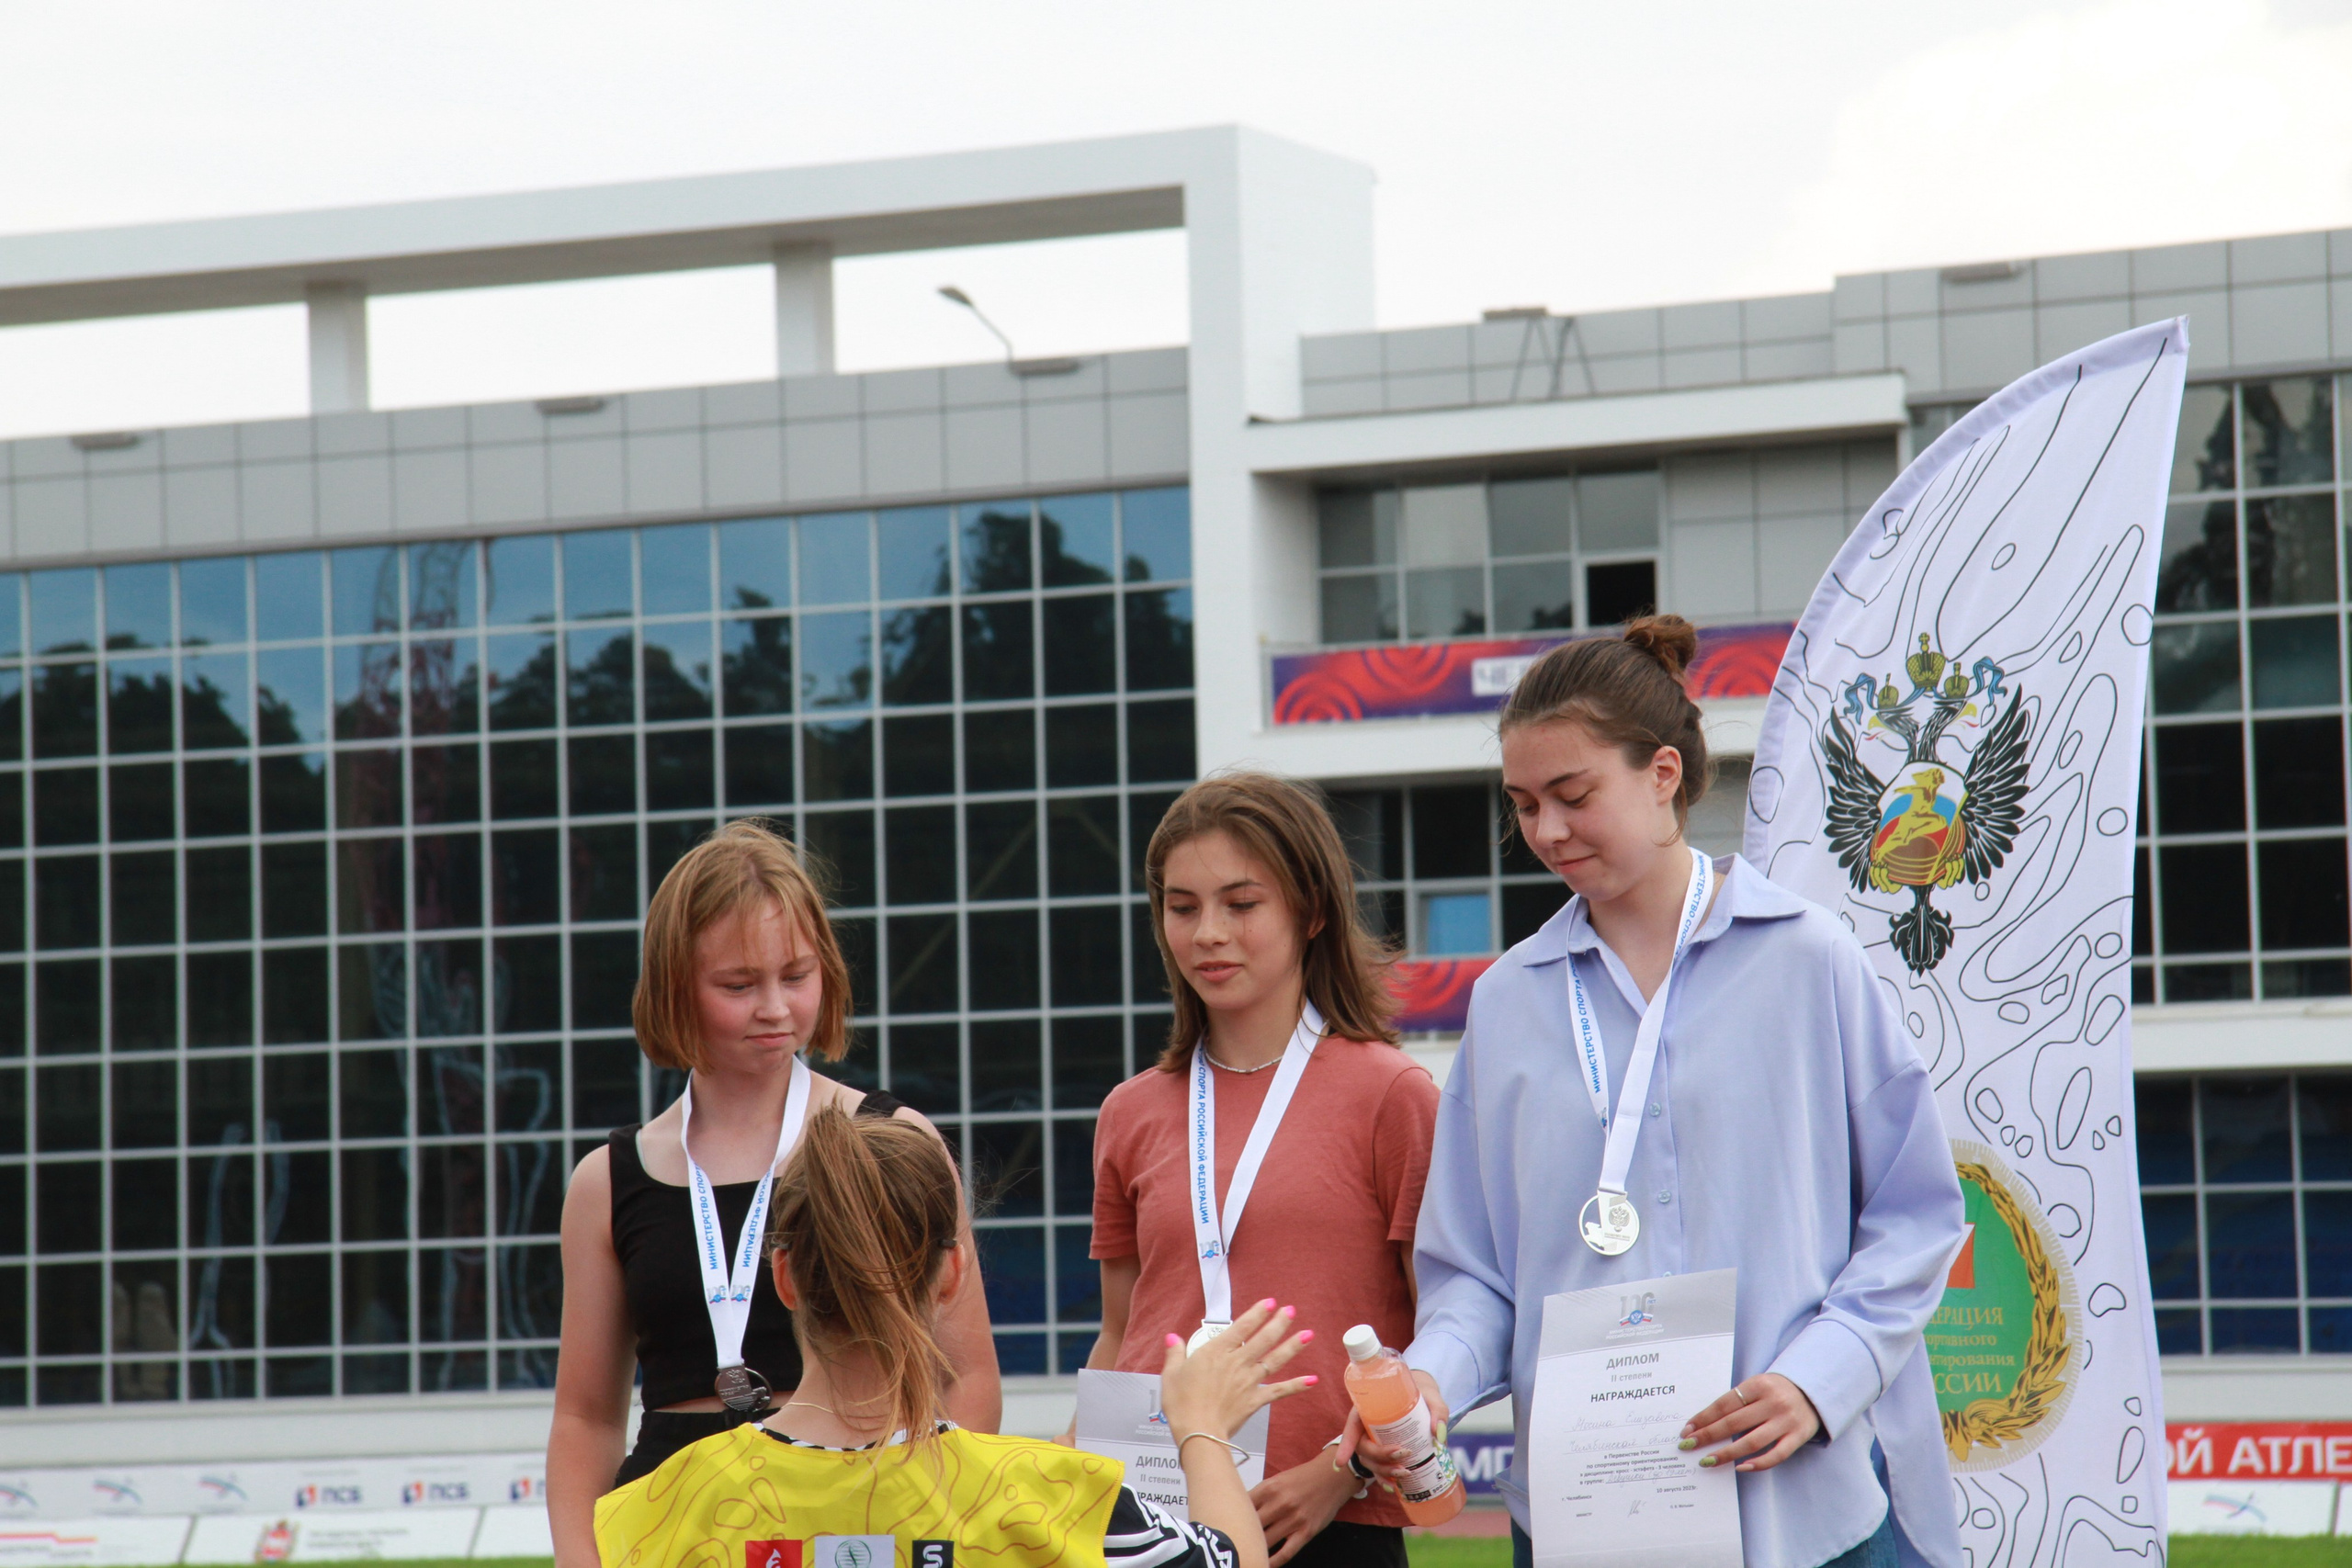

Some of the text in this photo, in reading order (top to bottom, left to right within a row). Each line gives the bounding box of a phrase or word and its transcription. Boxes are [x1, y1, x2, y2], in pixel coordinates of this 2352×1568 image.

[1575, 978, 1600, 1094] МИНИСТЕРСТВО СПОРТА
[1197, 1066, 1206, 1101] СПОРТА
[1197, 1102, 1209, 1162] РОССИЙСКОЙ
[1197, 1164, 1210, 1224] ФЕДЕРАЦИИ
[695, 1163, 718, 1270] МИНИСТЕРСТВО СПОРТ
[742, 1206, 762, 1268] ФЕДЕРАЦИИ
[1925, 1335, 1998, 1350] ортивного
[1606, 1352, 1660, 1371] ДИПЛОМ
[1619, 1371, 1653, 1382] степени
[1934, 1372, 2003, 1394] ССИИ
[1590, 1384, 1676, 1403] НАГРАЖДАЕТСЯ
[1594, 1461, 1630, 1470] спортивному
[1630, 1456, 1679, 1467] ориентированию
[1608, 1451, 1639, 1460] Первенстве
[1148, 1475, 1182, 1485] степени
[1664, 1486, 1682, 1495] августа
